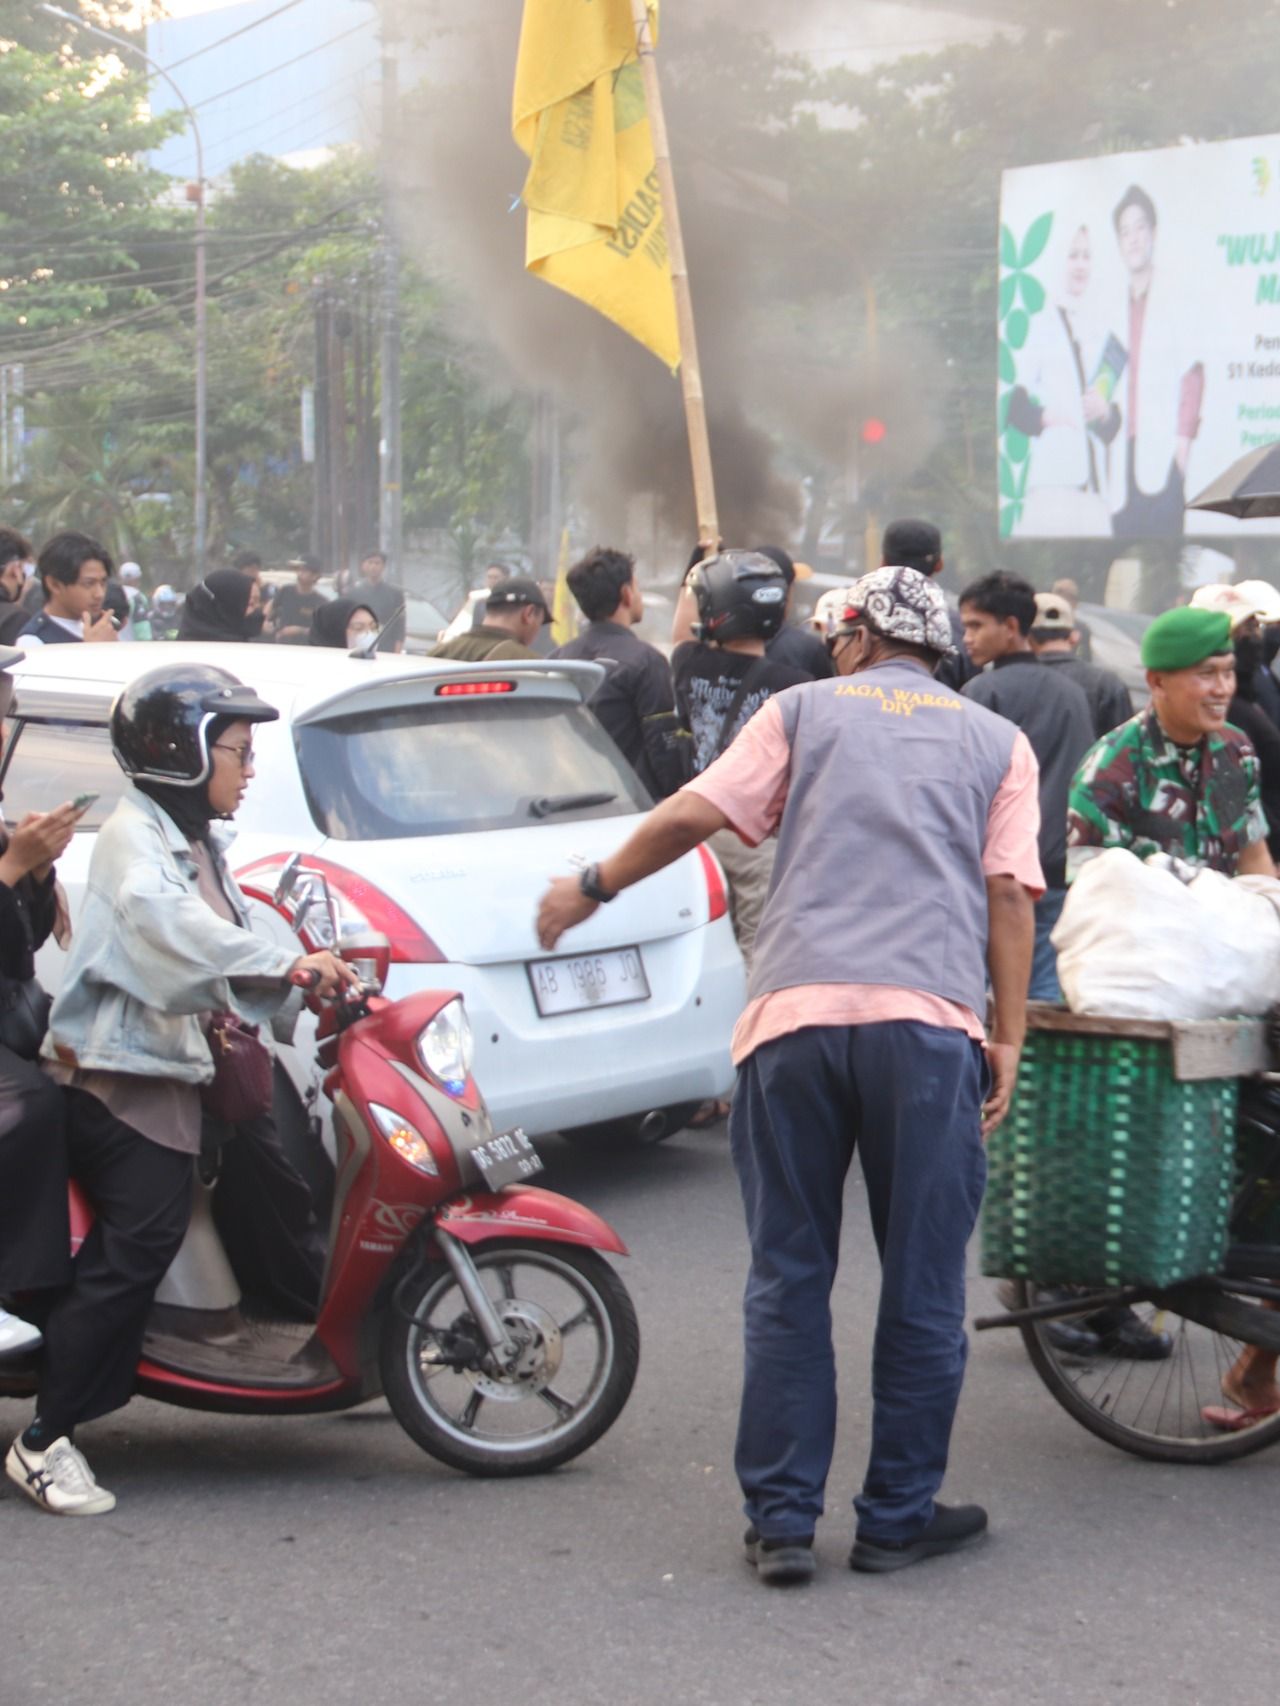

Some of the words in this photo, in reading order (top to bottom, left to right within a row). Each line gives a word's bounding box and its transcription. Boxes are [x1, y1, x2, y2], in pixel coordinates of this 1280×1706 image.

[1227, 361, 1243, 380] S1
[834, 684, 884, 698] JAGA
[893, 688, 963, 710] WARGA
[881, 699, 914, 716] DIY
[538, 966, 558, 993] AB
[567, 959, 607, 990] 1986
